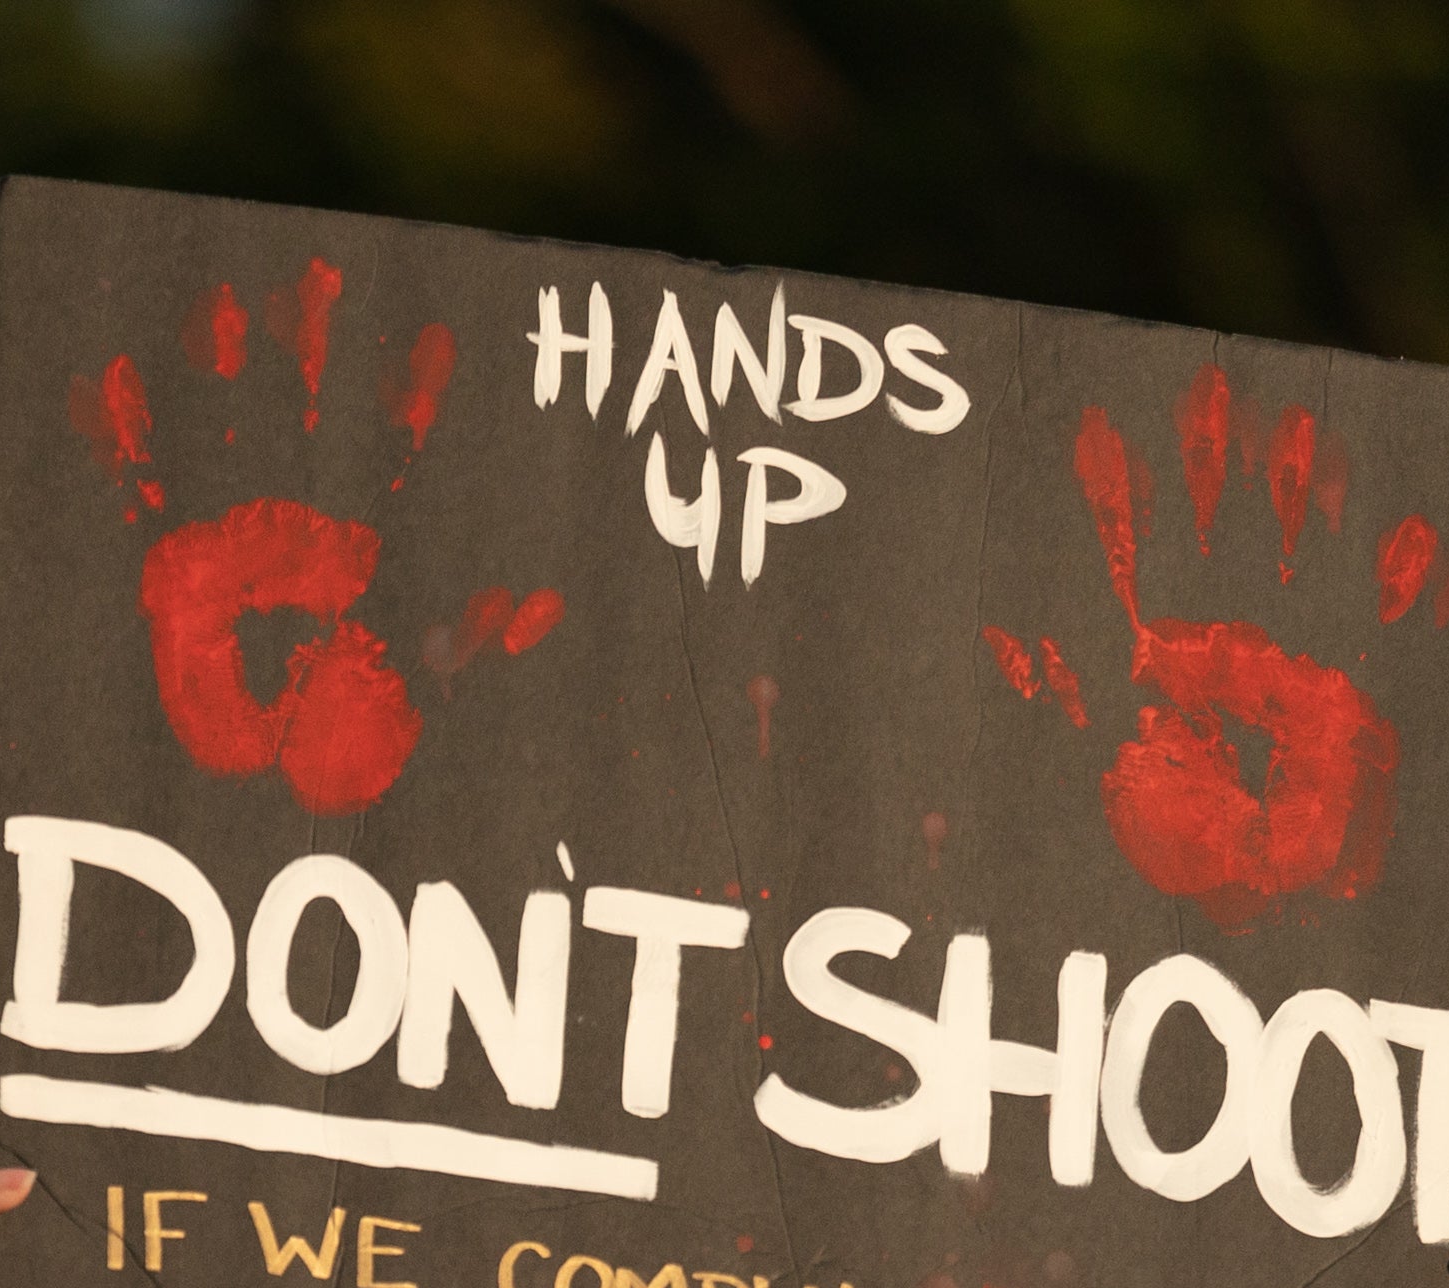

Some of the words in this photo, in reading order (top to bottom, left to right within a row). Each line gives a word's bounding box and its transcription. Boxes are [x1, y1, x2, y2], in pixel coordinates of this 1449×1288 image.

[526, 278, 971, 437] HANDS
[645, 431, 847, 591] UP
[1, 814, 750, 1118] DON'T
[107, 1186, 208, 1272] IF
